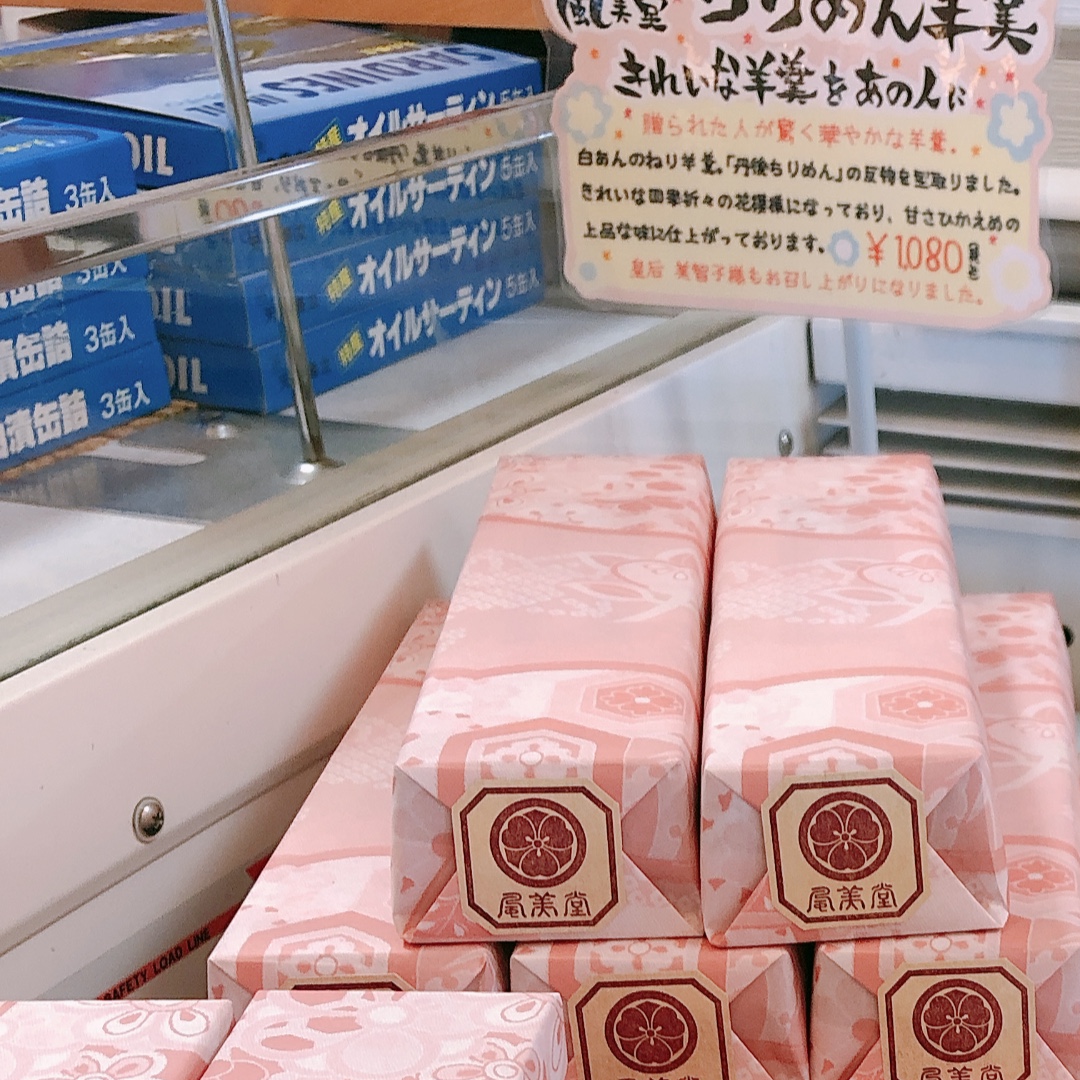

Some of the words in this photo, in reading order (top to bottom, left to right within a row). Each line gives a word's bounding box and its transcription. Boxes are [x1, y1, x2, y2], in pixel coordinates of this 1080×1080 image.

[500, 209, 538, 242] 5缶入
[504, 267, 542, 299] 5缶入
[84, 314, 136, 354] 3缶入
[100, 380, 150, 420] 3缶入
[152, 944, 184, 977] LOAD
[186, 927, 211, 953] LINE
